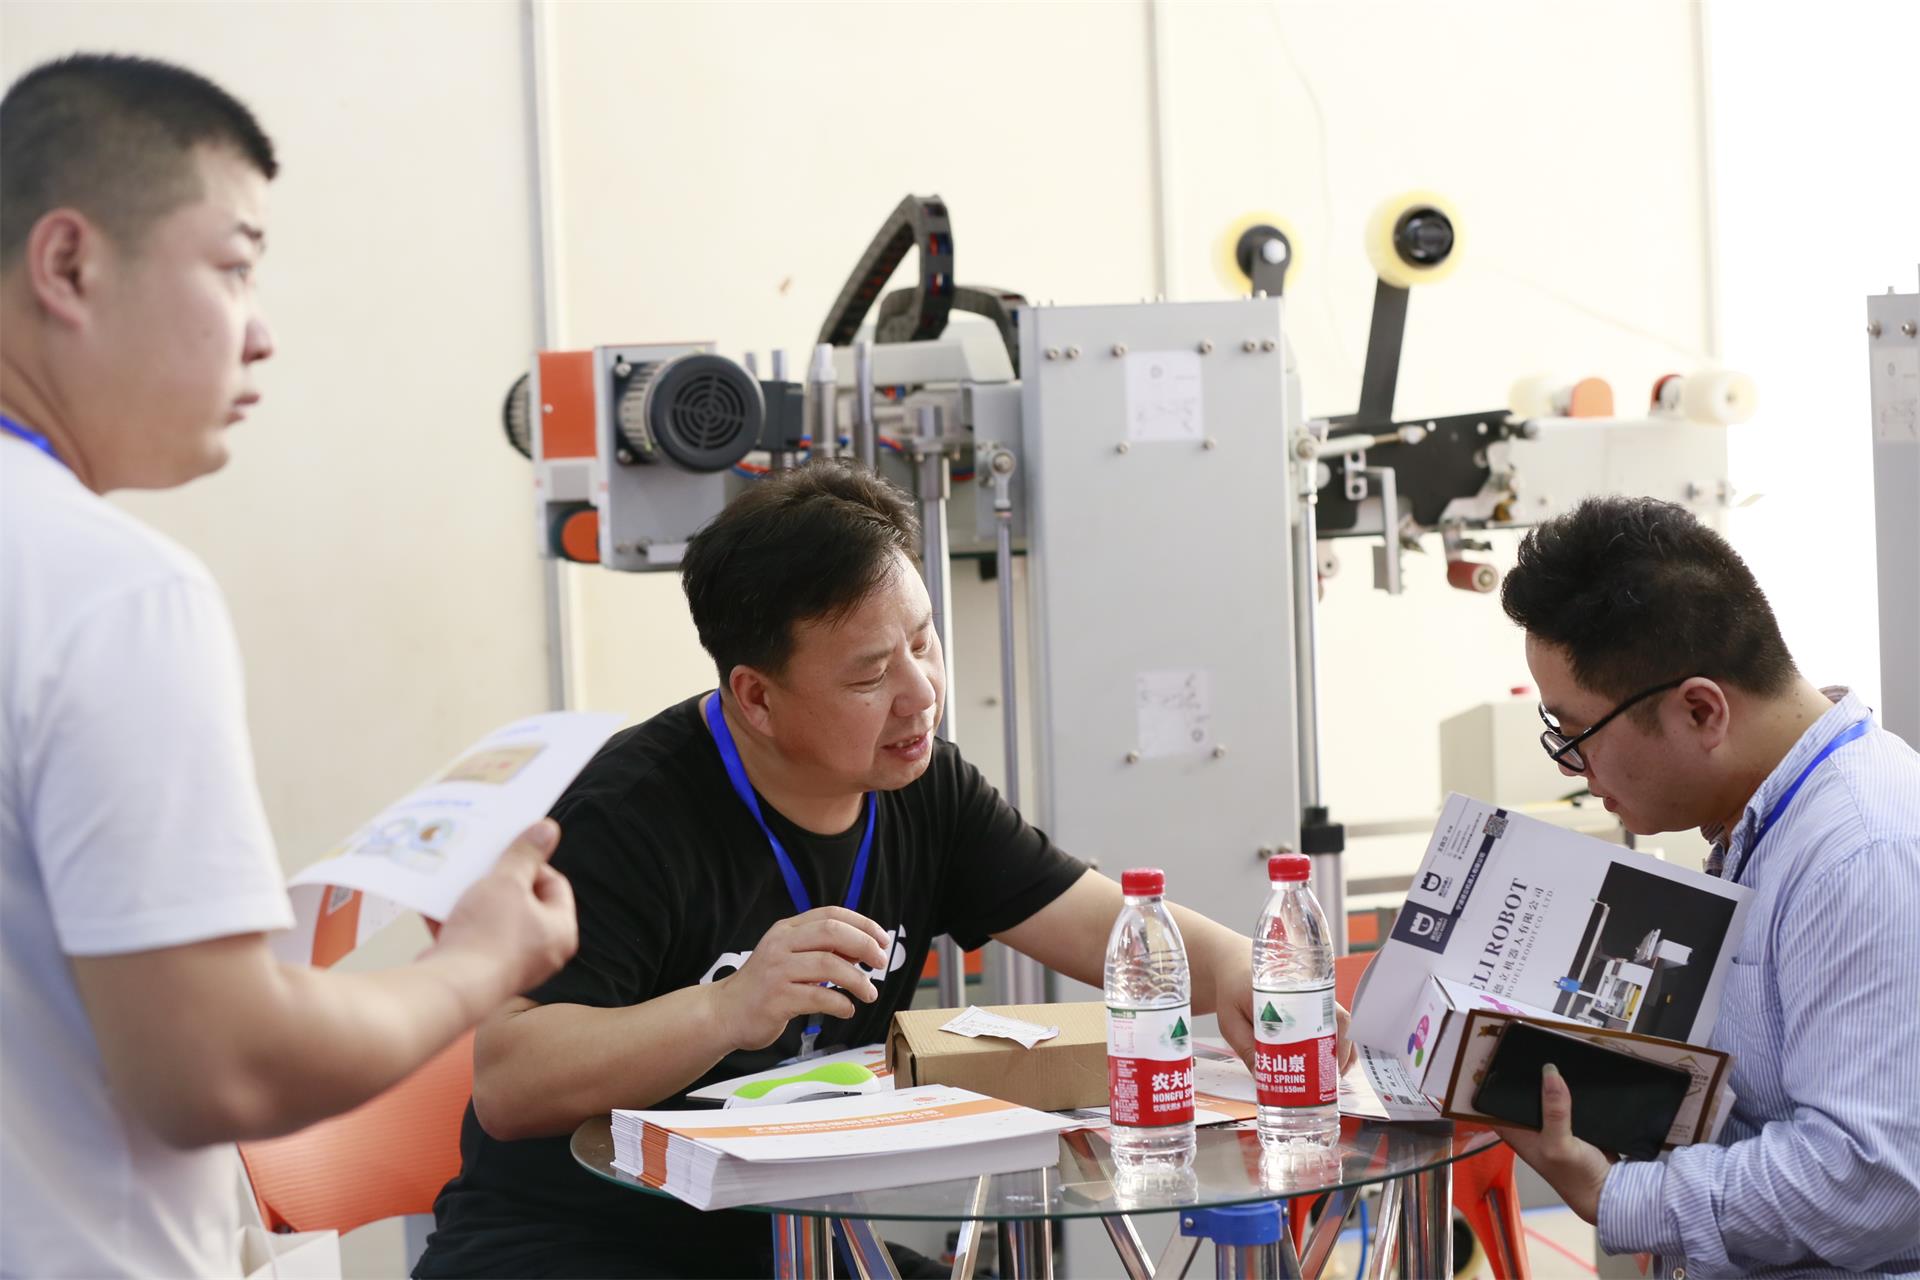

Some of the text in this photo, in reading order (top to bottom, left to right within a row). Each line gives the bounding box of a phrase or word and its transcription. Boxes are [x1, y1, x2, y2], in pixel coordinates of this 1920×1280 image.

[1484, 877, 1528, 957] ROBOT
[1274, 1074, 1306, 1084] SPRING
[1153, 1090, 1184, 1103] NONGFU
